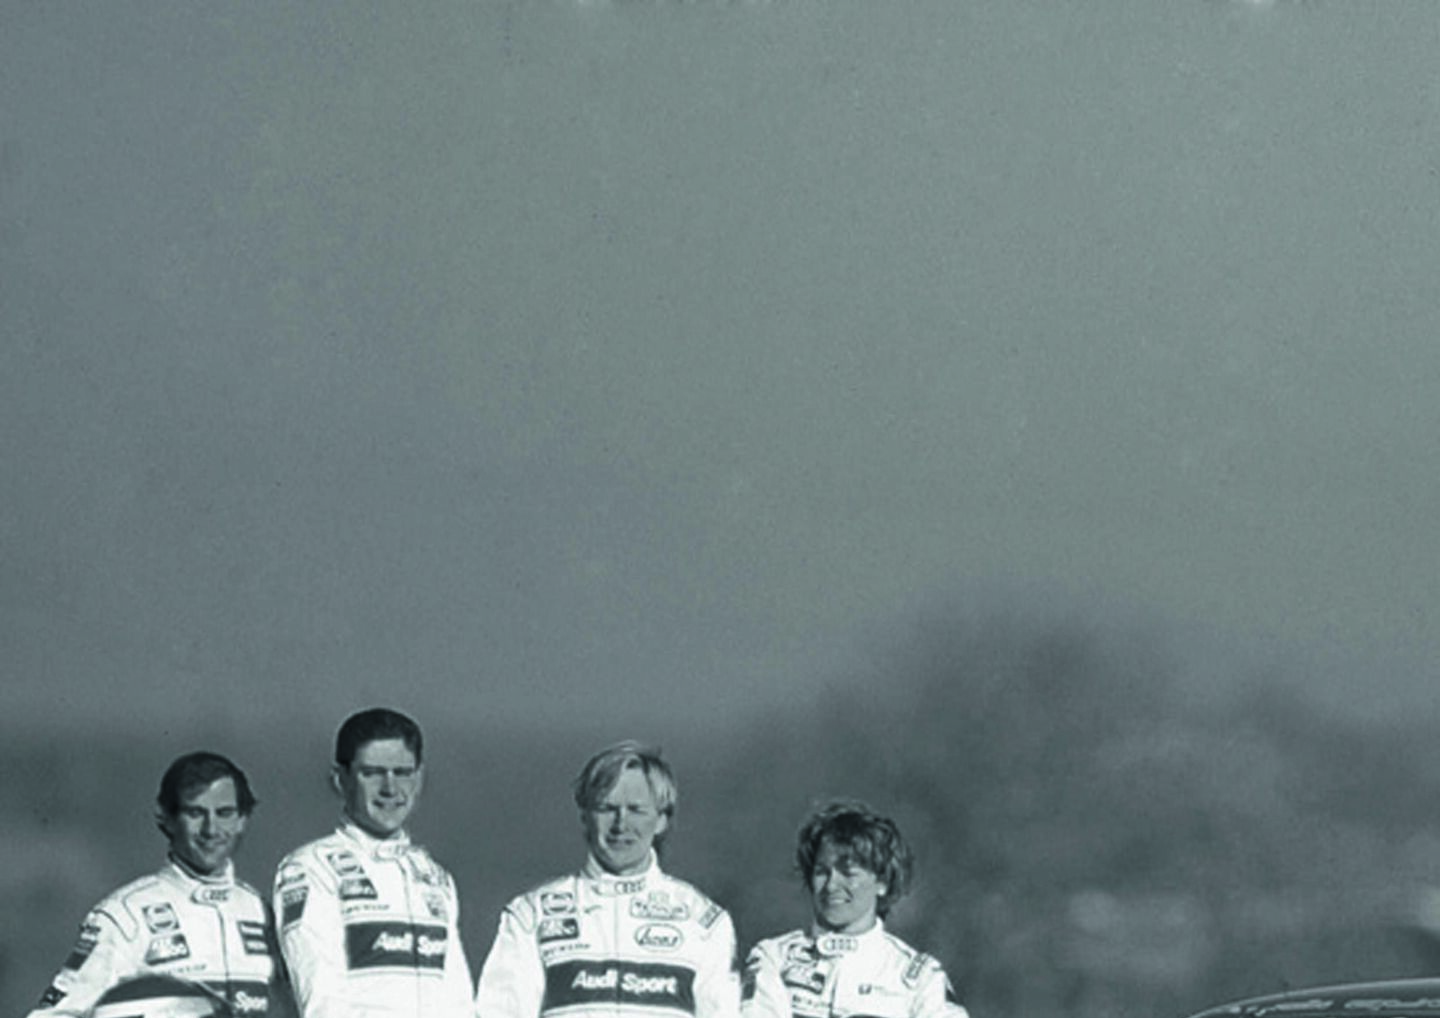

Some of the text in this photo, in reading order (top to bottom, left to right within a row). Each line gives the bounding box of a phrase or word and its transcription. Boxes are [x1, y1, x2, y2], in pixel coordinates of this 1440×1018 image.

[372, 932, 413, 951] Audi
[571, 968, 678, 995] Audi Sport
